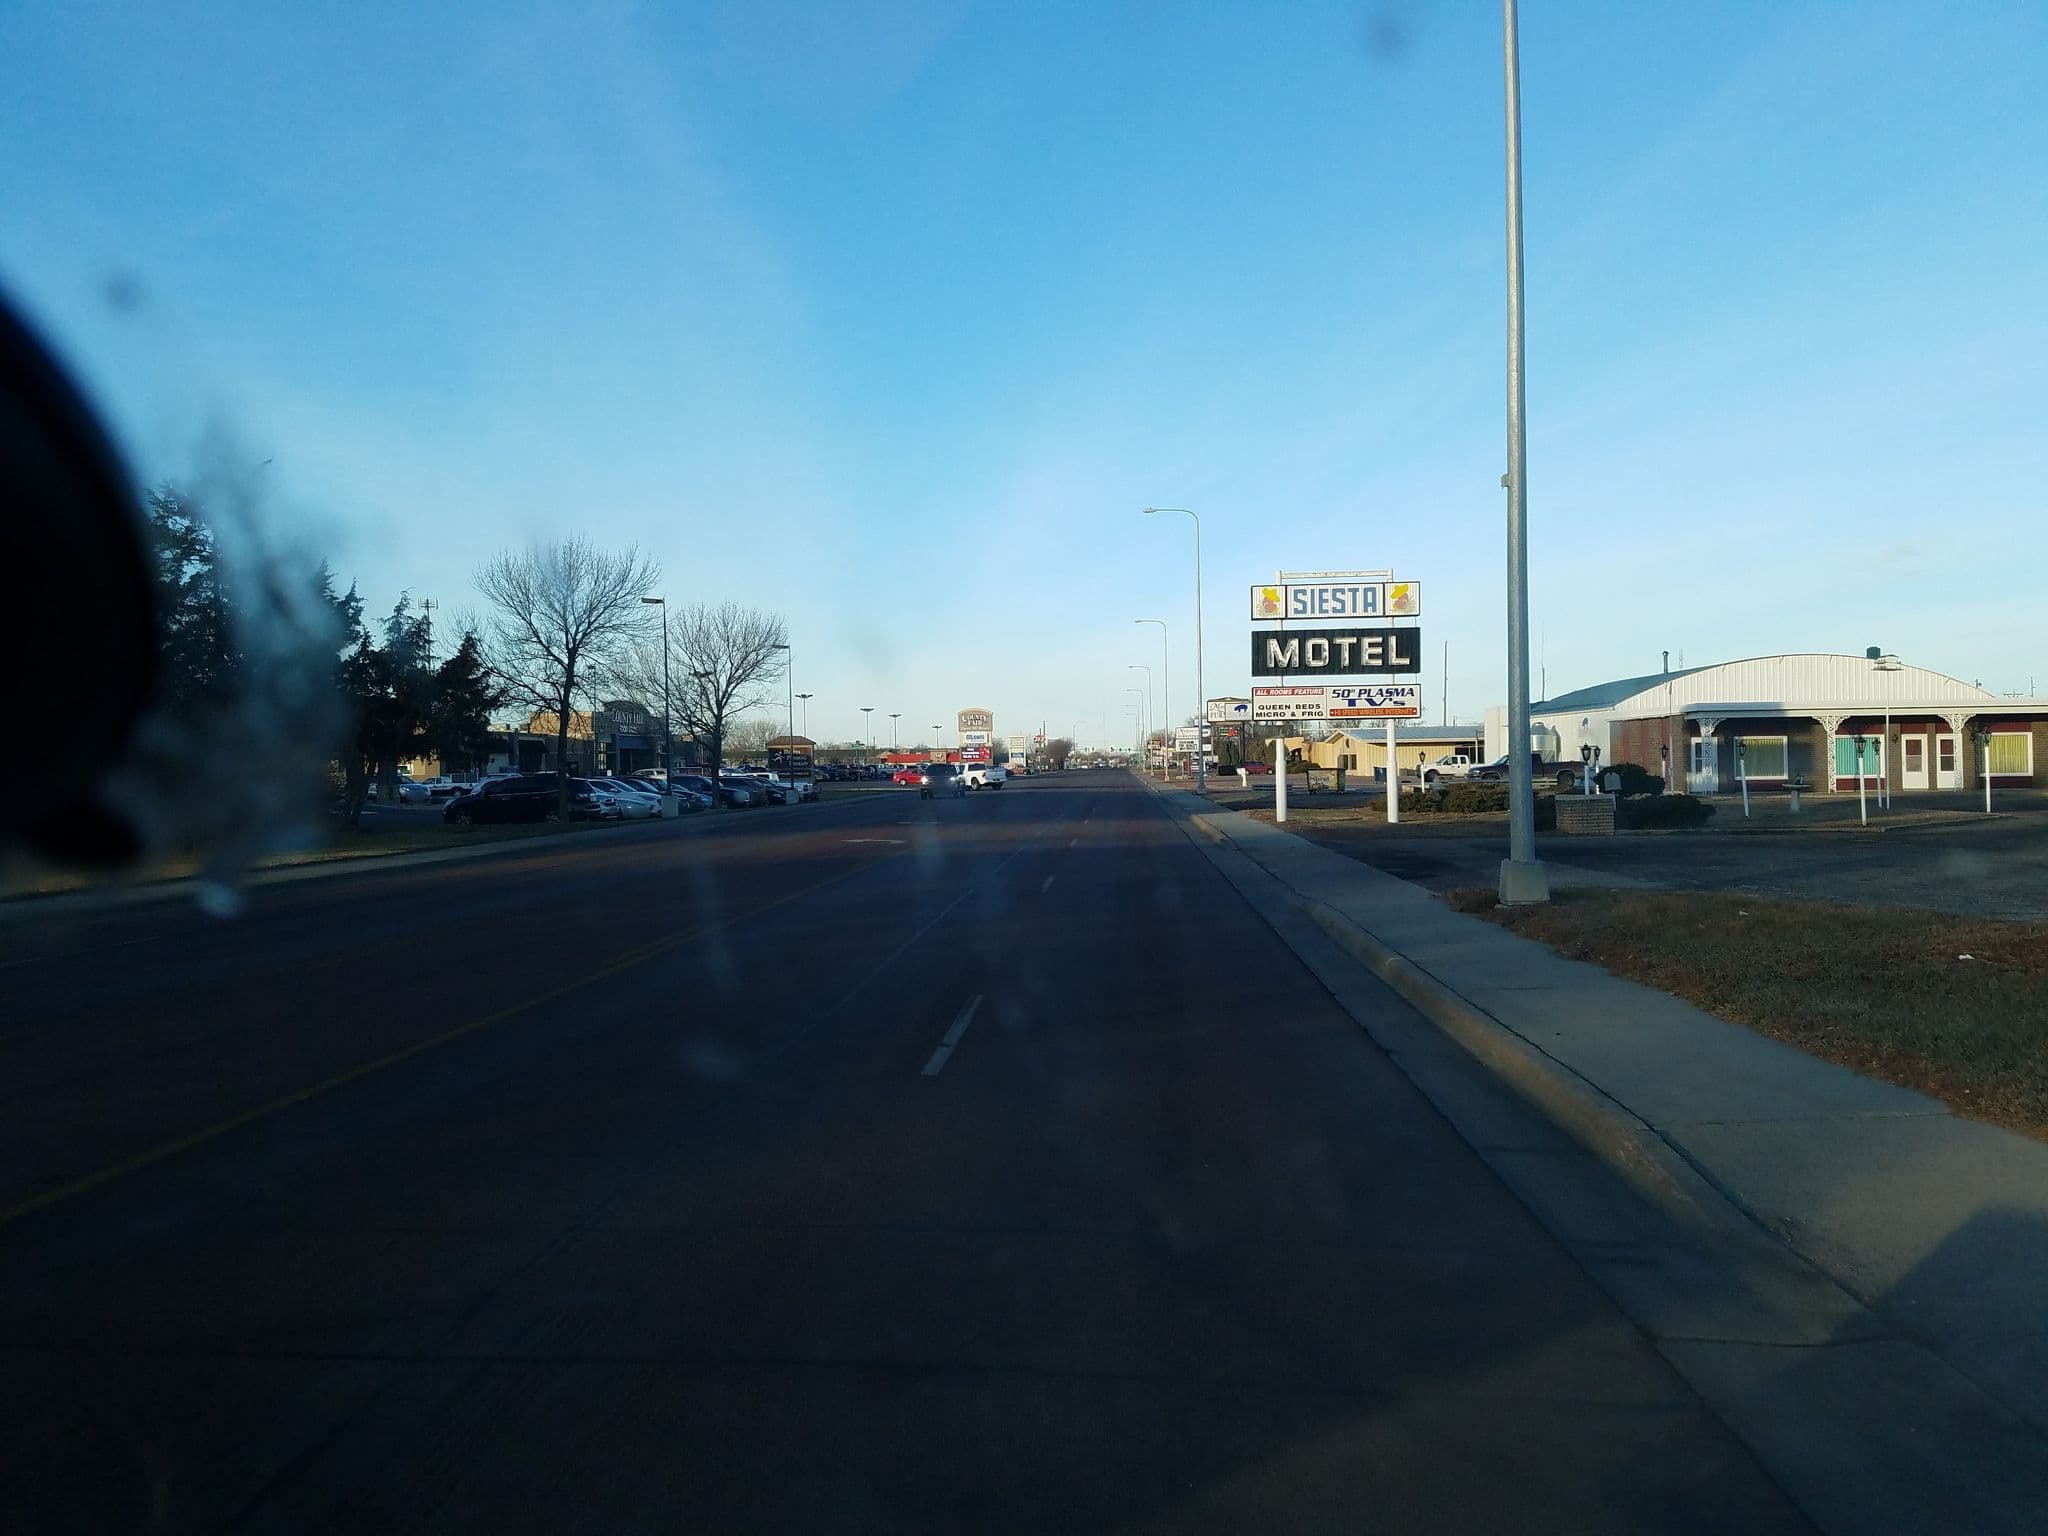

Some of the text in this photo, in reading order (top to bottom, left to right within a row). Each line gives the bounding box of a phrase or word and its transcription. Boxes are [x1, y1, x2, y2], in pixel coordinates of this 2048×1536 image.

[1293, 587, 1377, 614] SIESTA
[1266, 635, 1410, 668] MOTEL
[1294, 687, 1323, 695] FEATURE
[1358, 687, 1415, 698] PLASMA
[1302, 710, 1324, 718] FRIG
